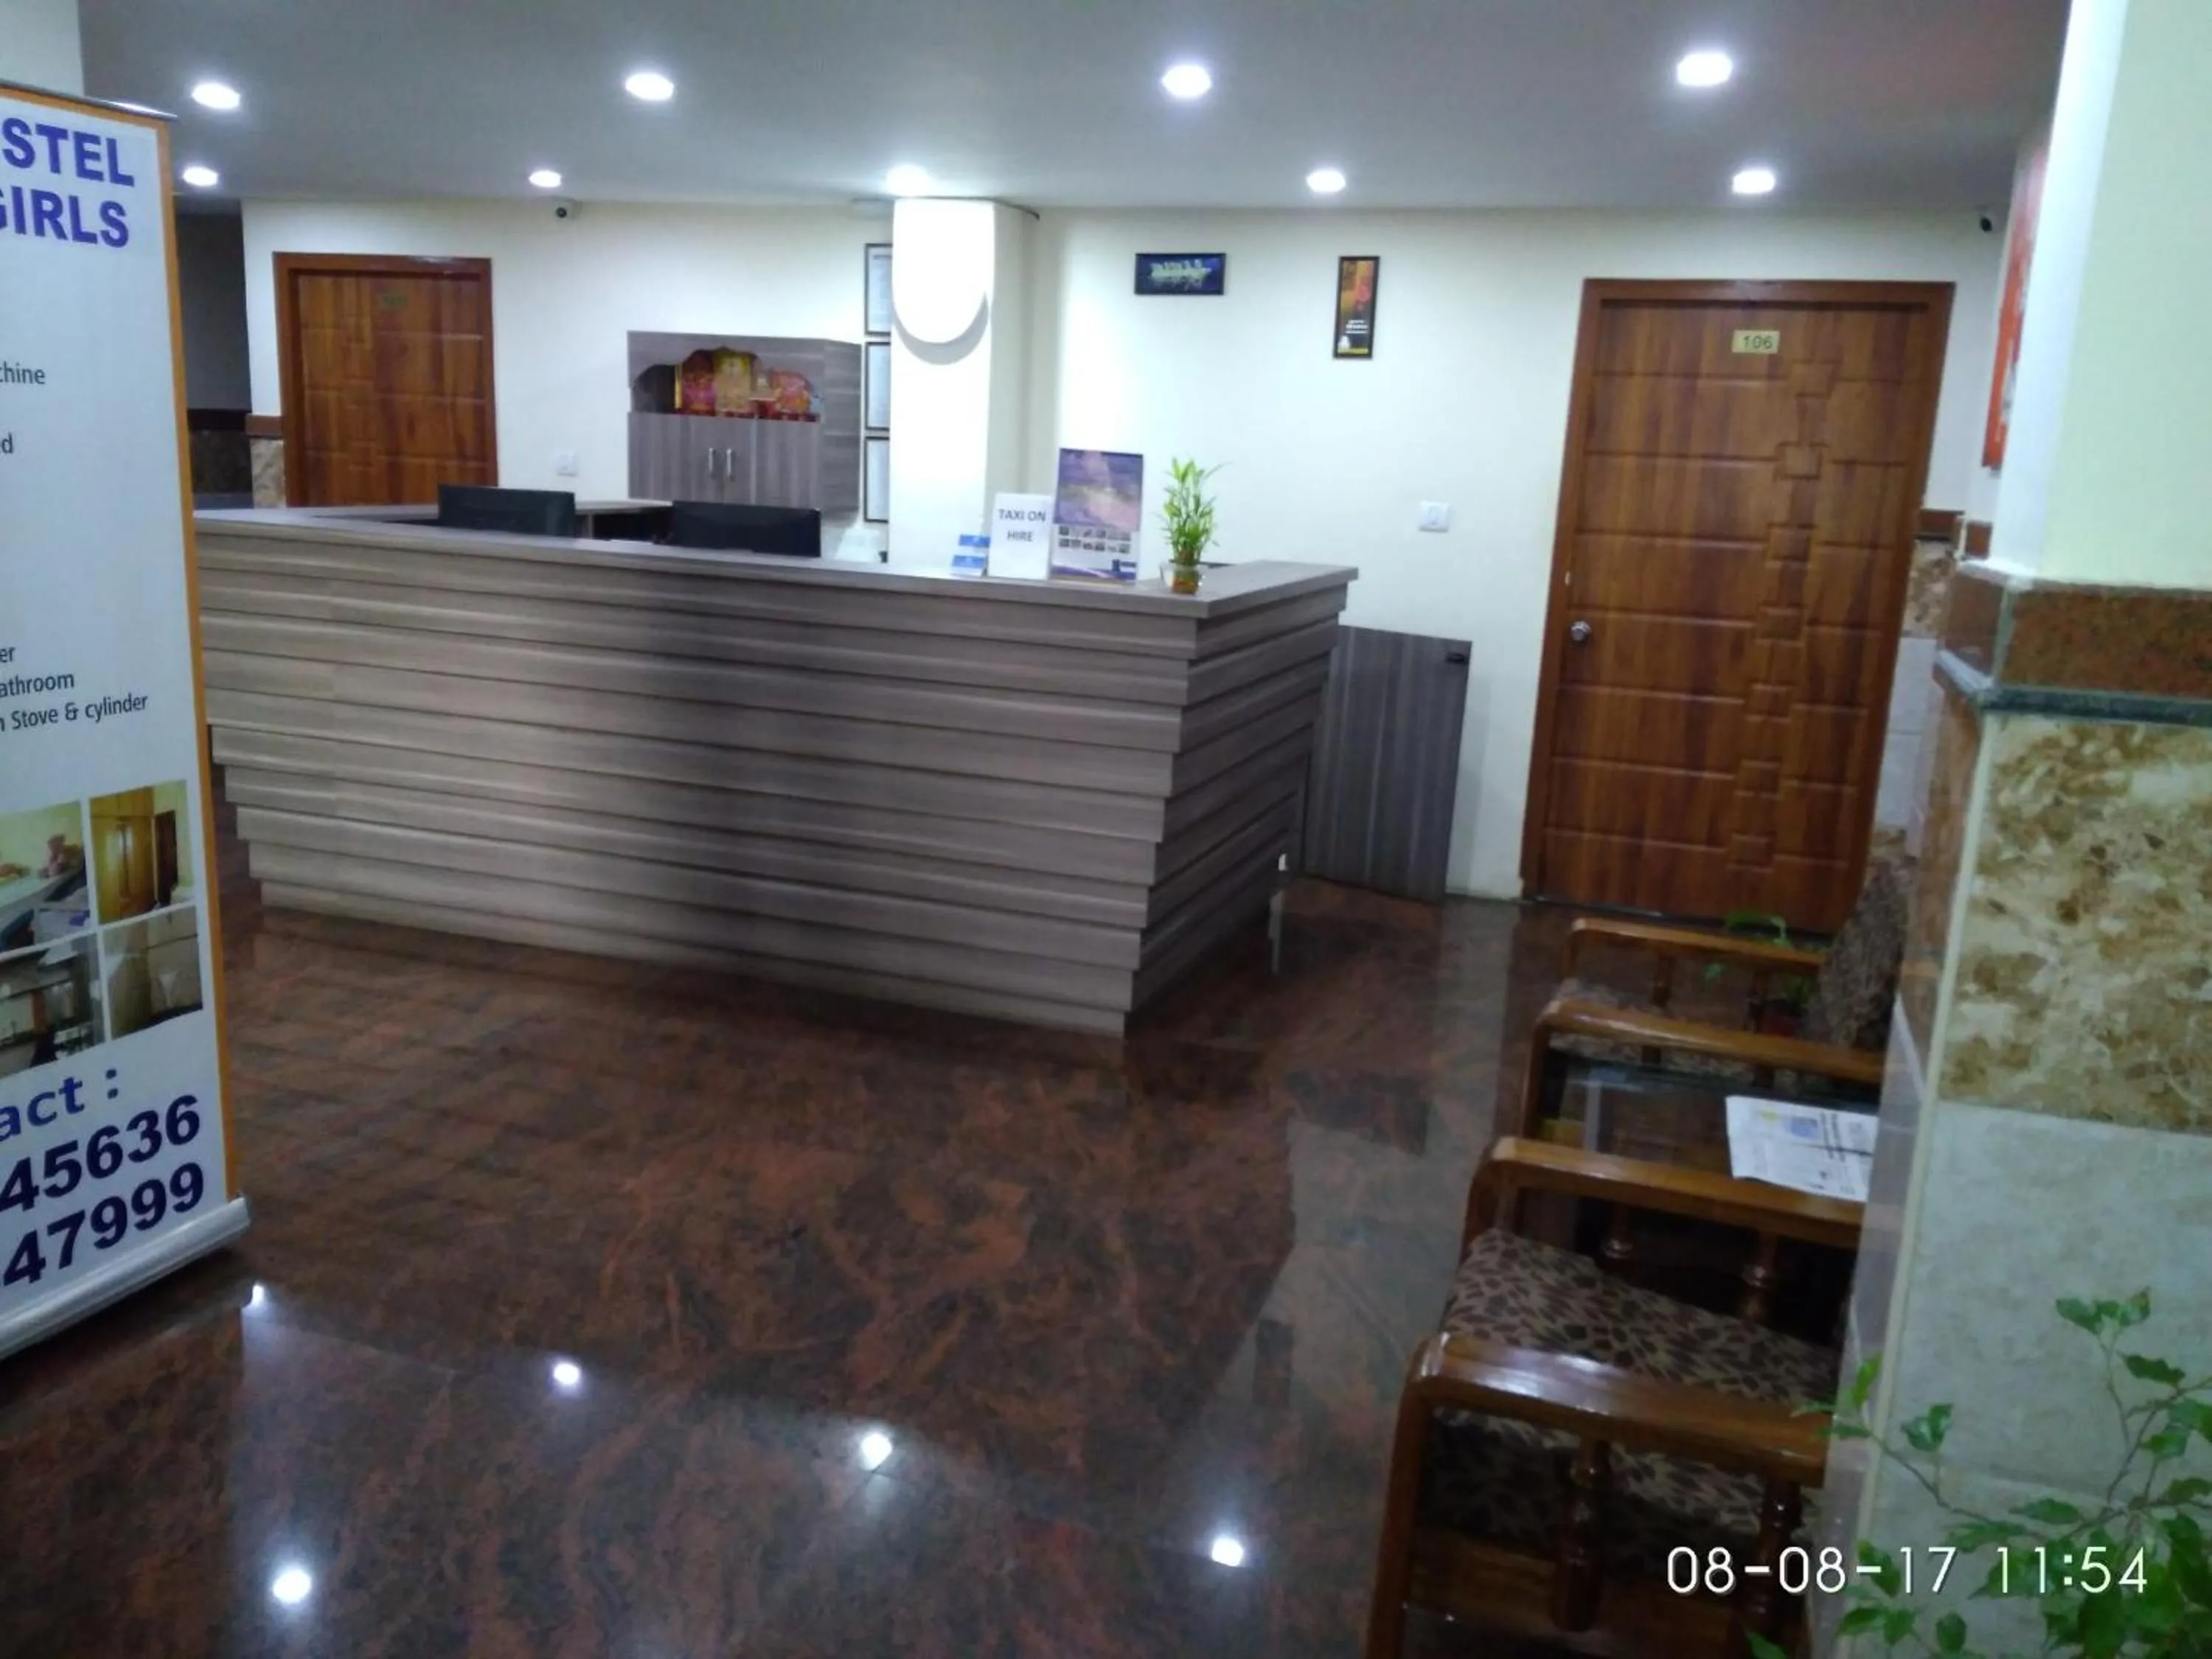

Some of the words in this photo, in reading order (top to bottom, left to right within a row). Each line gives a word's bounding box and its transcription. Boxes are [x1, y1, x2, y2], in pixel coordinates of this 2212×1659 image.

[1743, 335, 1773, 349] 106
[998, 509, 1025, 521] TAXI
[1028, 510, 1046, 522] ON
[1007, 531, 1033, 542] HIRE
[11, 709, 58, 730] Stove
[65, 702, 79, 721] &
[85, 693, 148, 723] cylinder
[0, 1095, 200, 1212] 45636
